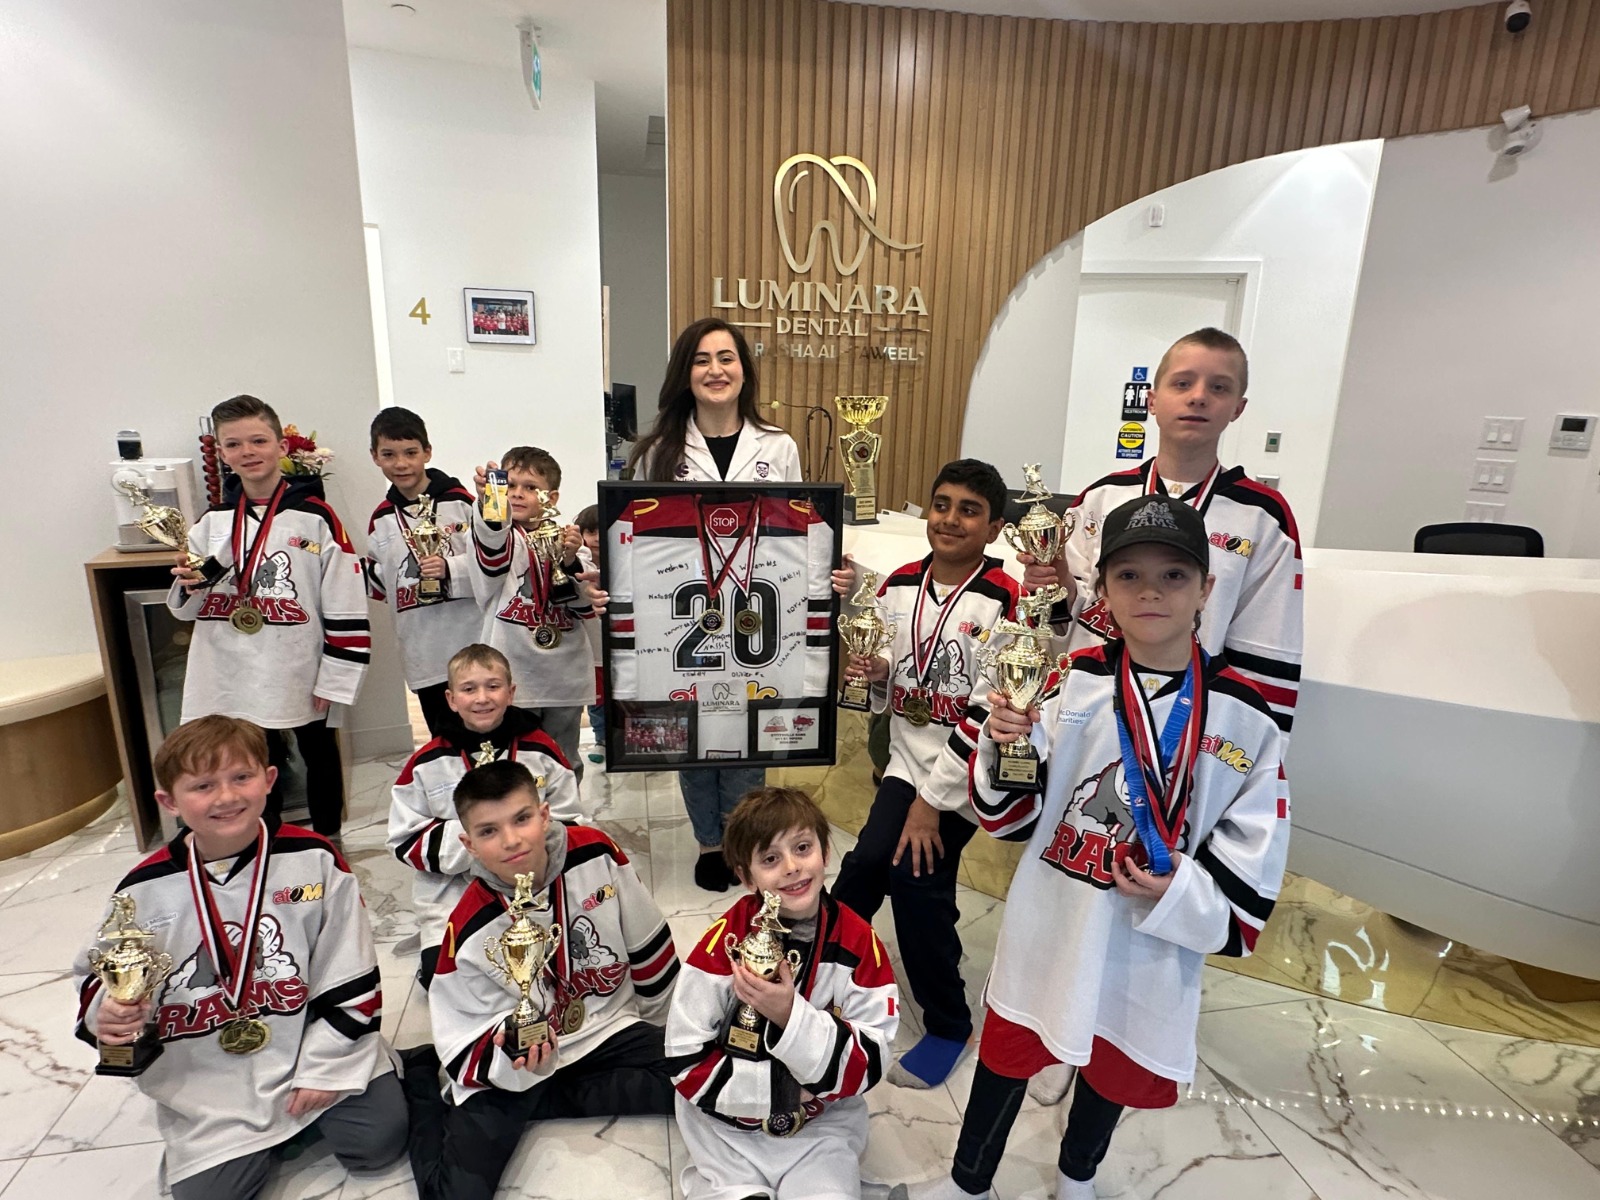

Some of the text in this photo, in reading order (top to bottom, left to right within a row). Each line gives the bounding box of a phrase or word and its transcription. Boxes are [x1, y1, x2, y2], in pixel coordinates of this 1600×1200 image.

[712, 277, 928, 315] LUMINARA
[408, 297, 431, 325] 4
[776, 317, 869, 337] DENTAL
[713, 517, 735, 527] STOP
[1124, 518, 1179, 531] RAMS
[672, 578, 781, 671] 20
[156, 975, 310, 1042] RAMS
